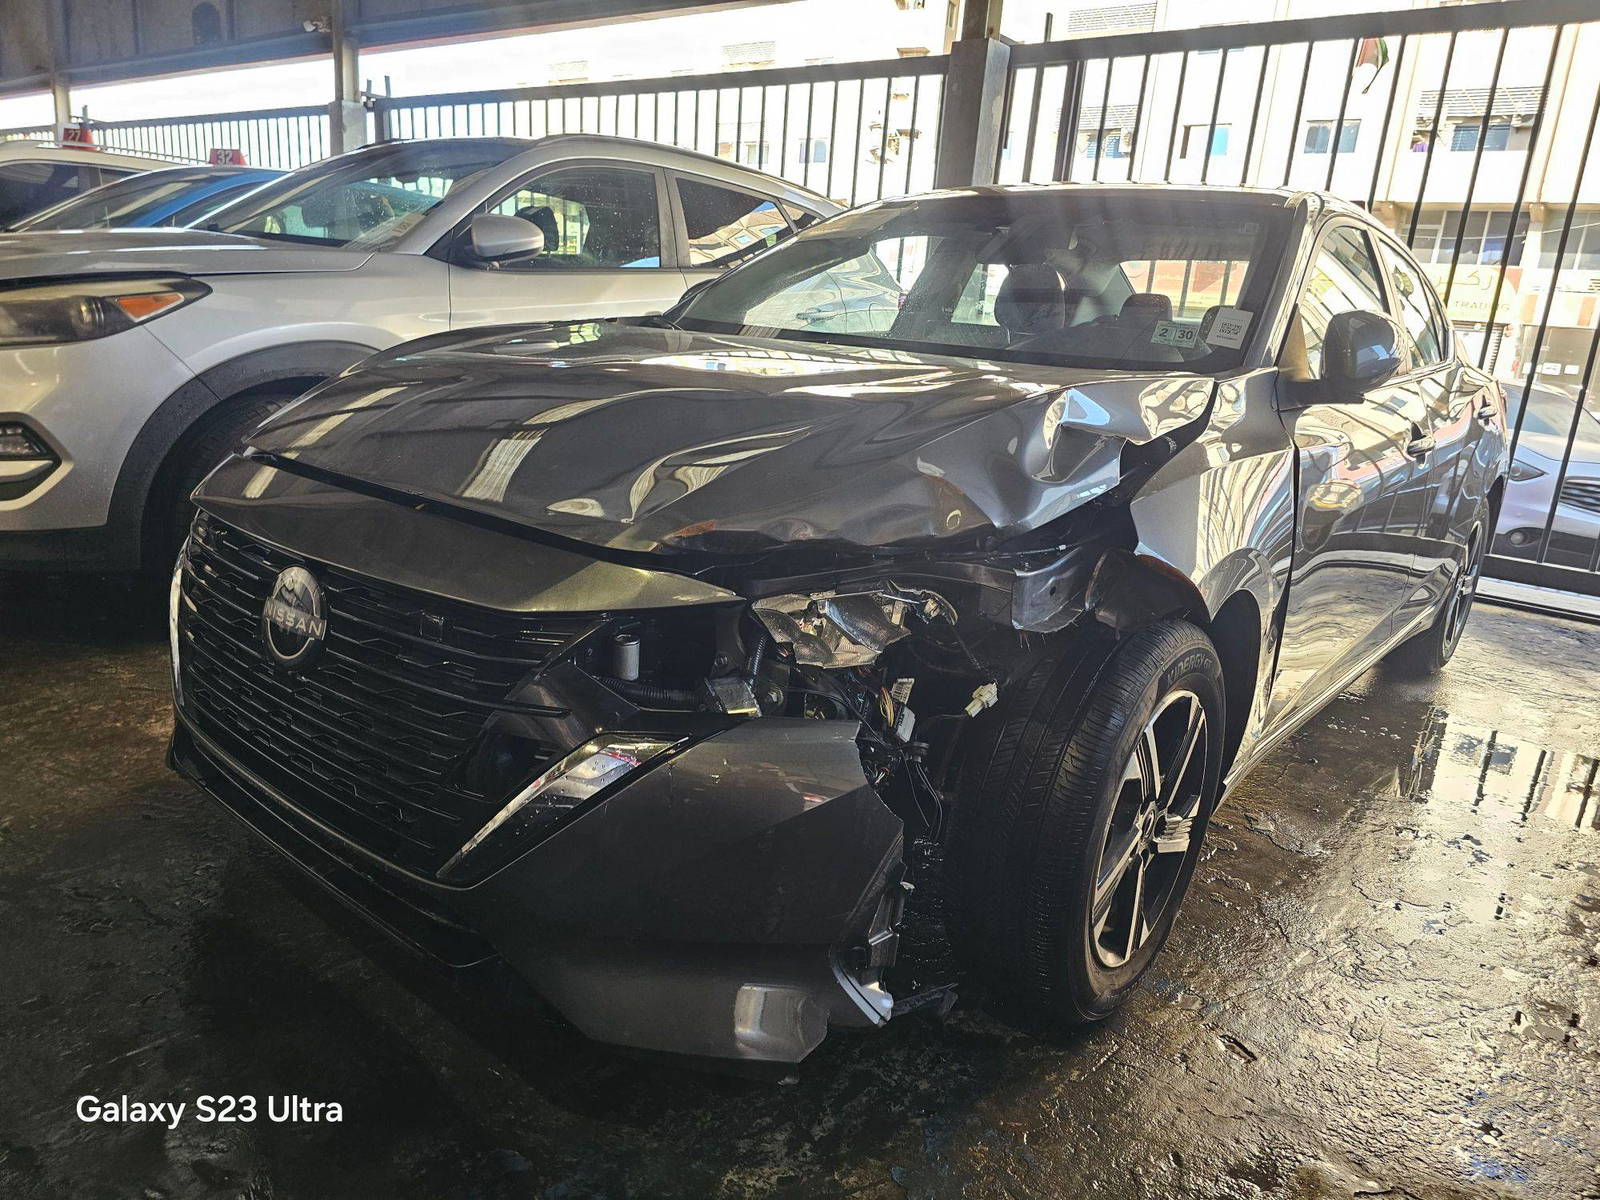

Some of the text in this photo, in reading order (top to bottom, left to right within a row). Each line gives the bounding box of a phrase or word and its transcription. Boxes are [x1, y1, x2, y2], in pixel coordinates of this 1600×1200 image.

[67, 129, 82, 142] 27
[215, 150, 233, 165] 32
[1455, 300, 1511, 312] TRADIG
[1158, 327, 1193, 340] 2 30
[263, 597, 323, 637] NISSAN
